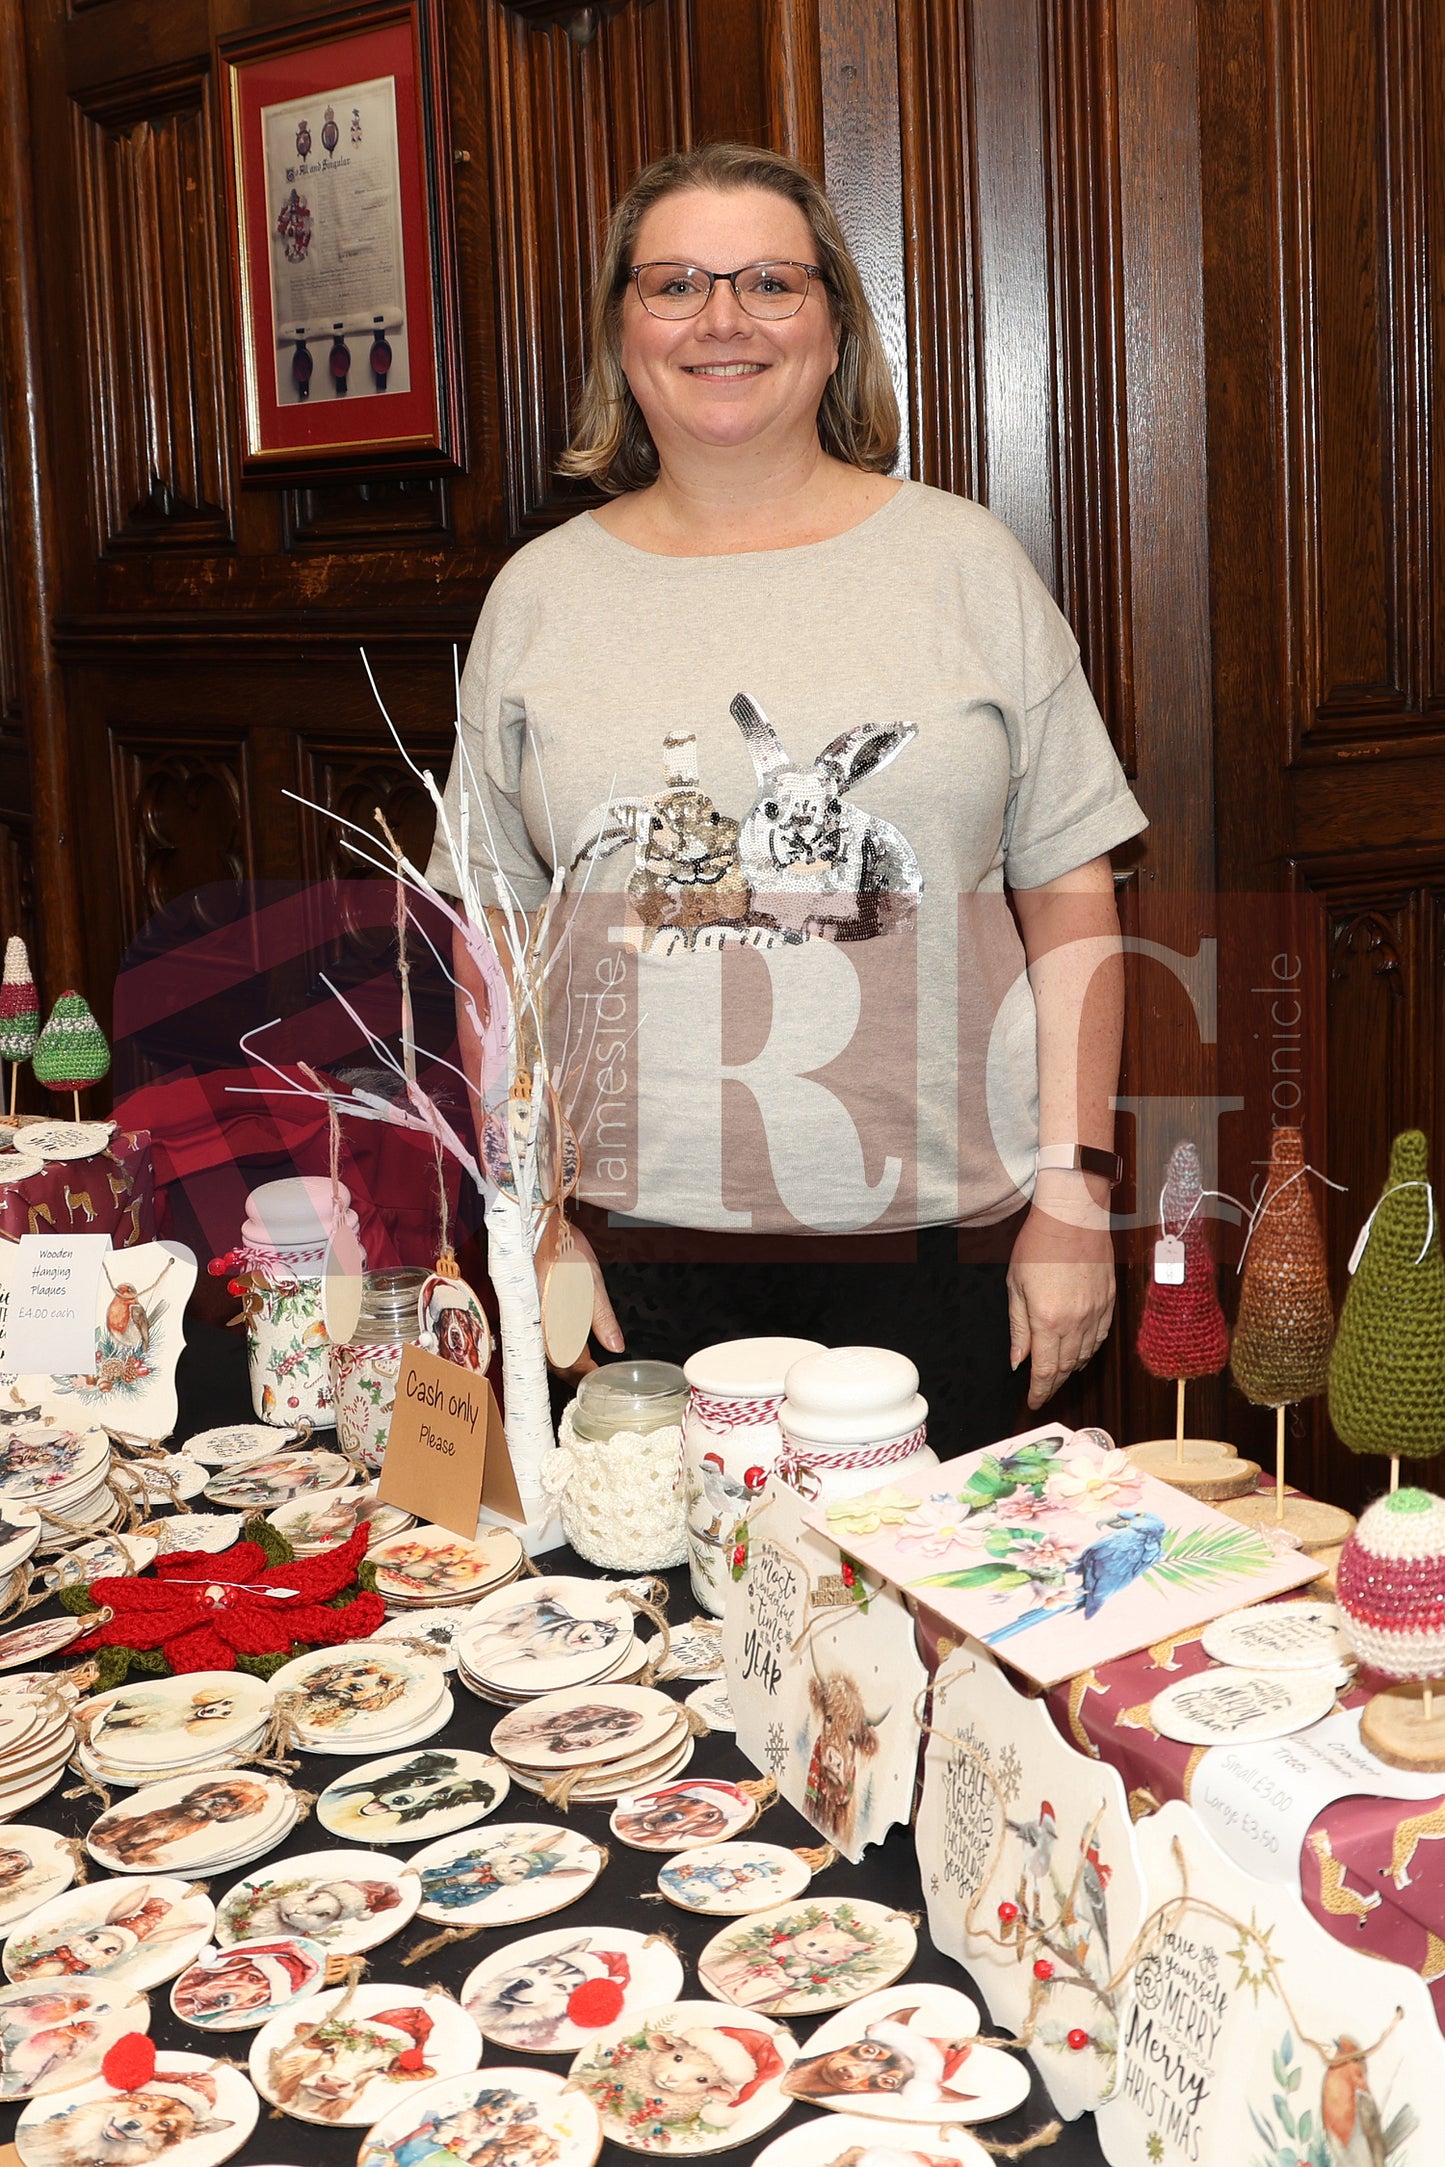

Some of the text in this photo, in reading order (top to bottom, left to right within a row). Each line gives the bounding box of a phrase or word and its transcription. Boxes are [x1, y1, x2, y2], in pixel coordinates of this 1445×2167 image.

[310, 162, 321, 173] and
[322, 156, 351, 172] Singular
[32, 1265, 71, 1281] Hanging
[39, 1249, 73, 1259] Wooden
[18, 1306, 48, 1319] £4.00
[51, 1308, 75, 1319] each
[30, 1285, 67, 1297] Plaques
[406, 1369, 479, 1434] Cash only
[419, 1423, 456, 1456] Please
[742, 1628, 782, 1696] YEAR
[1220, 1753, 1294, 1812] Small £3.00
[1162, 1981, 1222, 2060] MERRY
[1125, 2003, 1211, 2116] Merry
[1123, 2054, 1204, 2162] HRISTMAS
